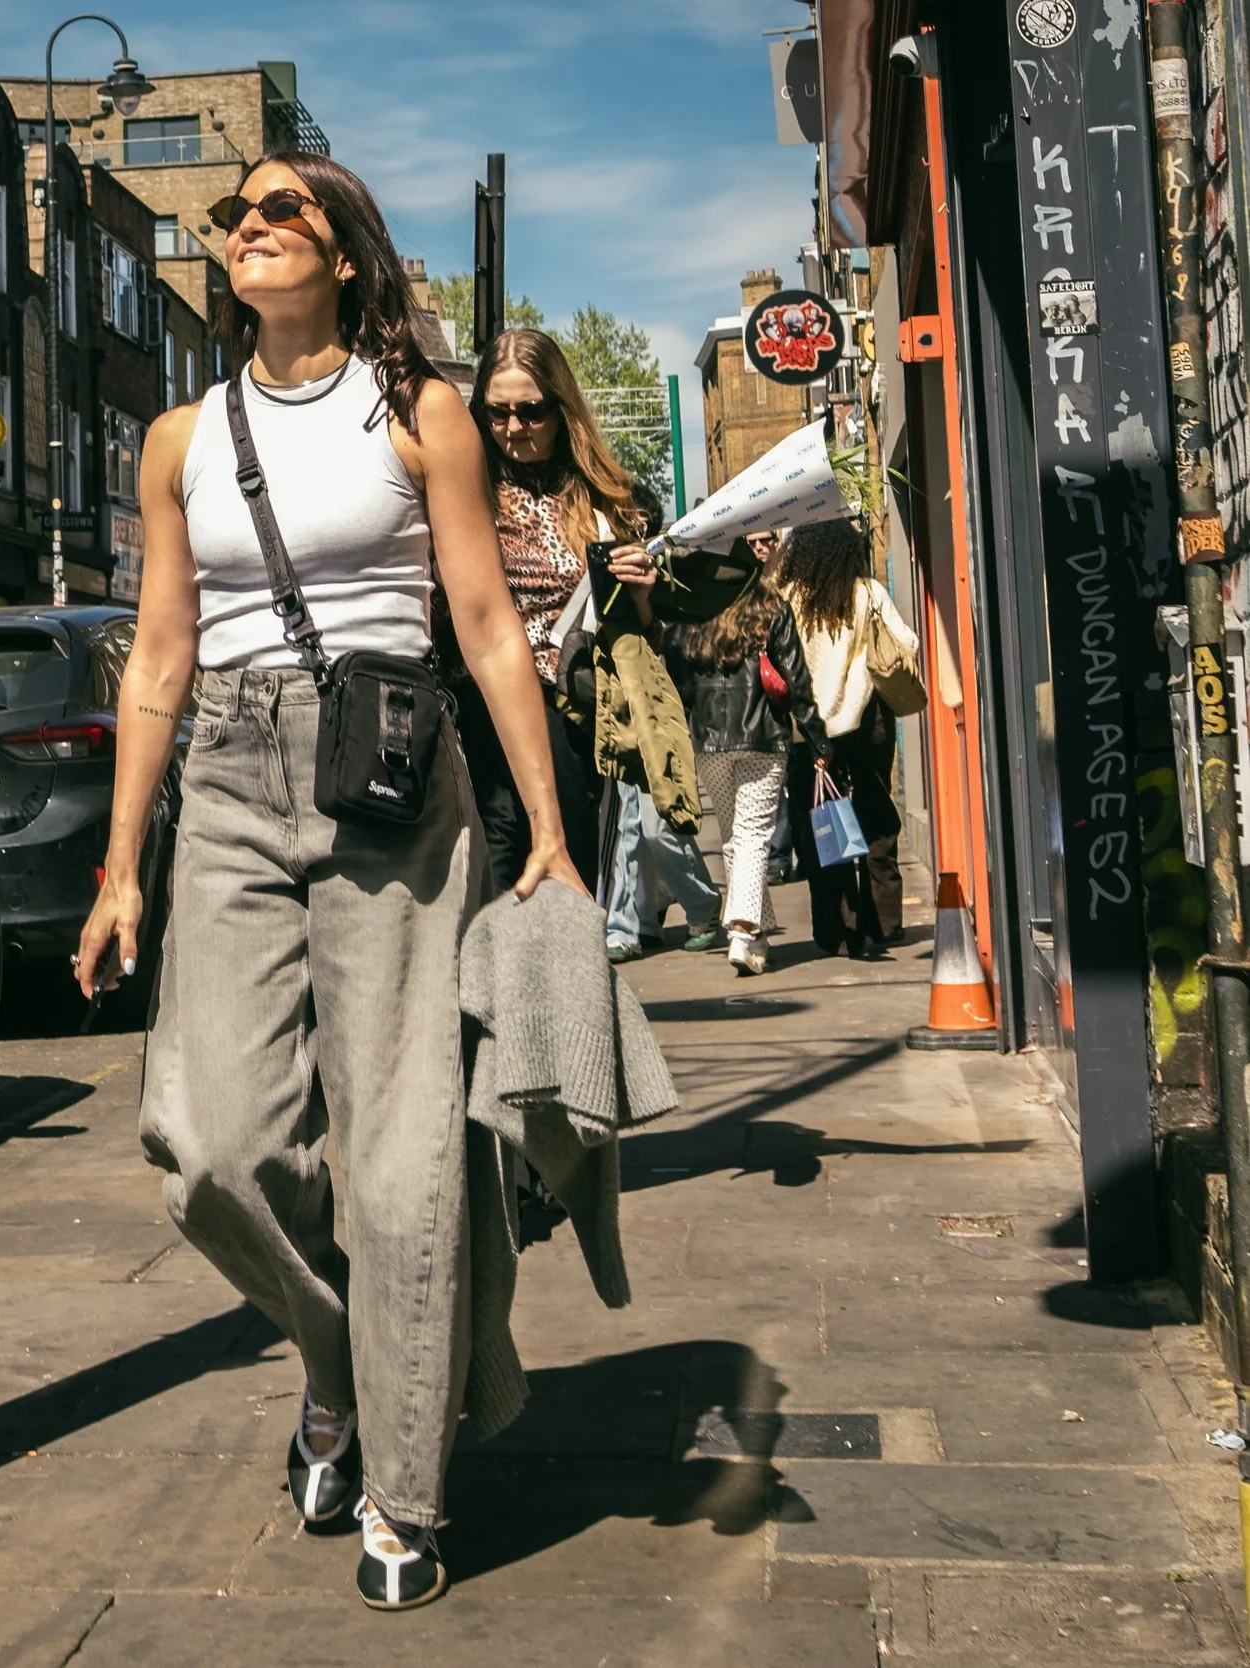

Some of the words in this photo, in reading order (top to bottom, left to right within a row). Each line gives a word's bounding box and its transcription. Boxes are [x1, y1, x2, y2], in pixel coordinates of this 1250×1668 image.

[1169, 78, 1187, 88] LTD
[1053, 324, 1088, 335] BERLIN
[1192, 645, 1228, 736] AOS
[1088, 831, 1132, 921] 52
